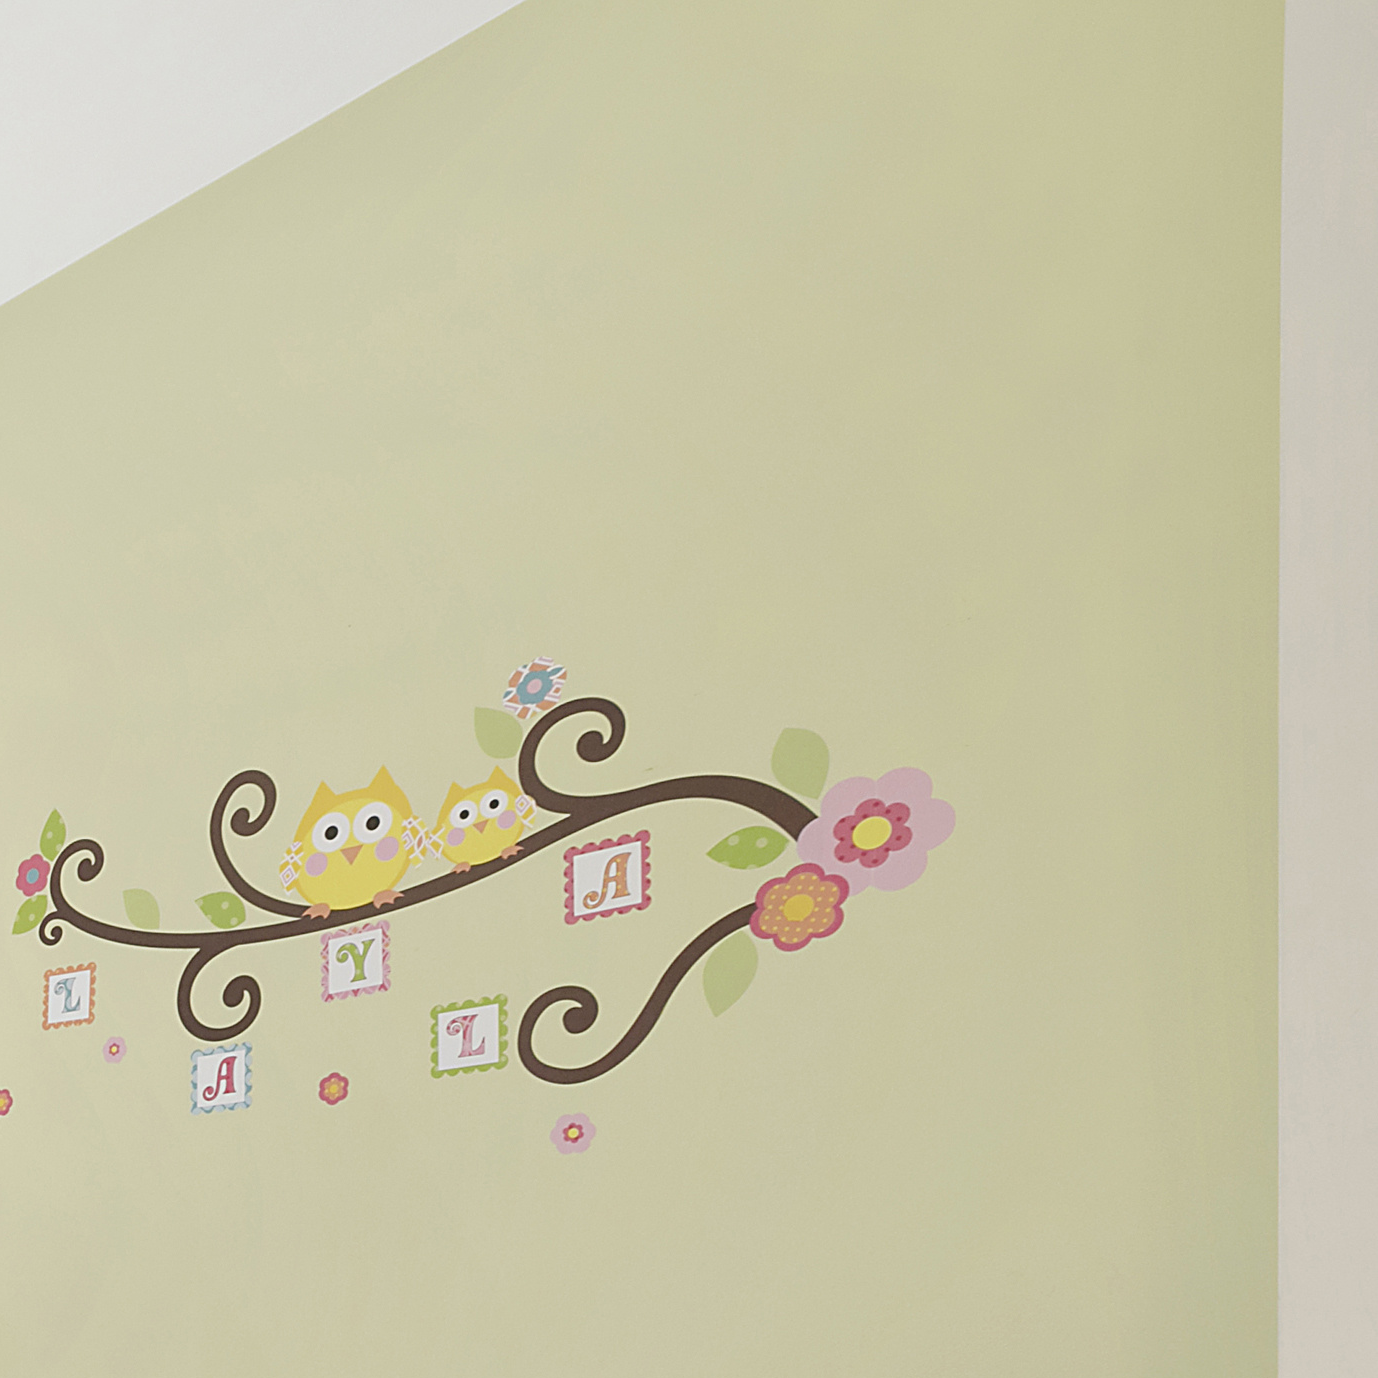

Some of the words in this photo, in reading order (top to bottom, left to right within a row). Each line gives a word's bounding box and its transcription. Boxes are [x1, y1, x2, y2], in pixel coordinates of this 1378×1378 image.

[54, 976, 81, 1014] L
[202, 1055, 238, 1102] A
[335, 937, 375, 983] Y
[445, 1013, 486, 1059] L
[582, 851, 632, 909] A
